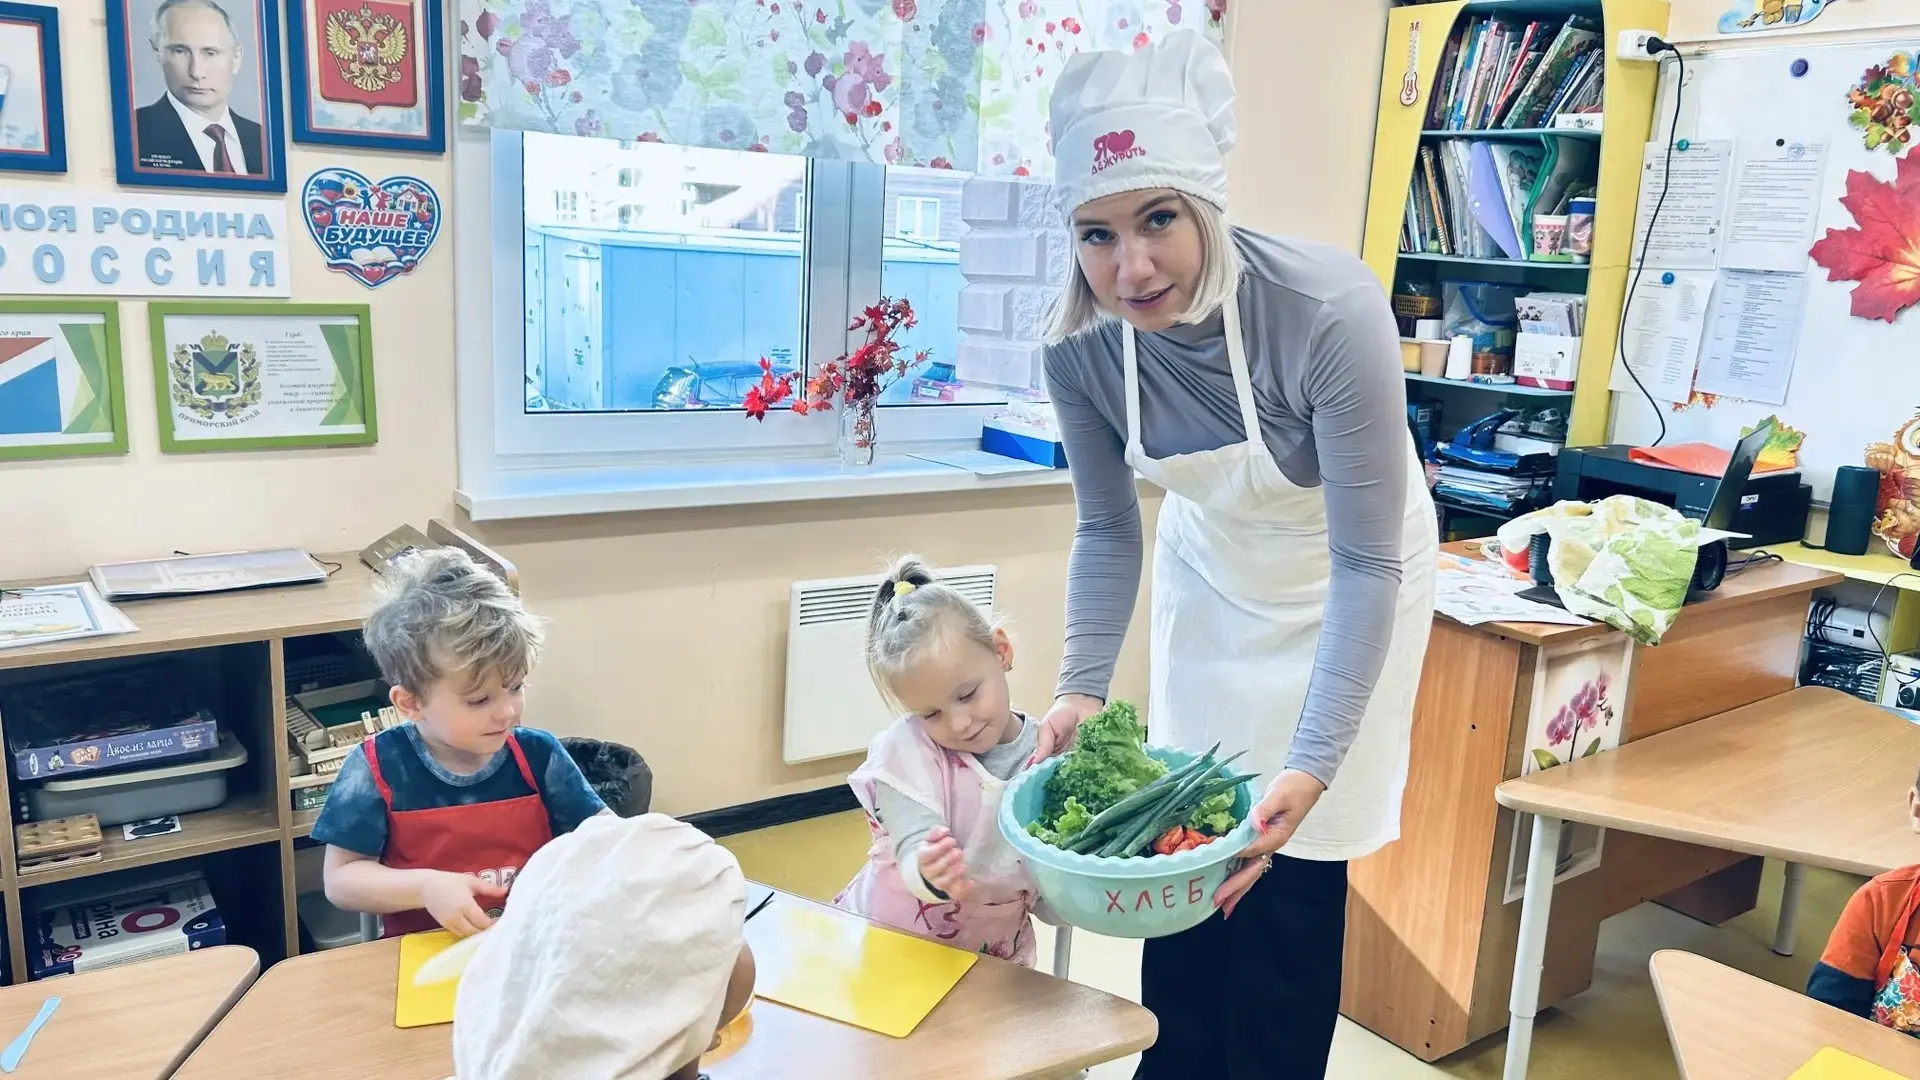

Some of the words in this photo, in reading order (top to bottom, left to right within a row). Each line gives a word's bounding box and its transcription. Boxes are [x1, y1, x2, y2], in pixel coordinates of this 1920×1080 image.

[1091, 146, 1146, 176] ДЕЖУРИТЬ
[1093, 134, 1108, 161] Я
[92, 206, 275, 241] РОДИНА
[339, 209, 410, 229] НАШЕ
[324, 226, 431, 247] БУДУЩЕЕ
[0, 243, 275, 287] ОССИЯ
[178, 412, 239, 428] ПРИМОРСКИЙ
[239, 409, 261, 424] КРАЙ
[1105, 876, 1208, 914] ХЛЕБ
